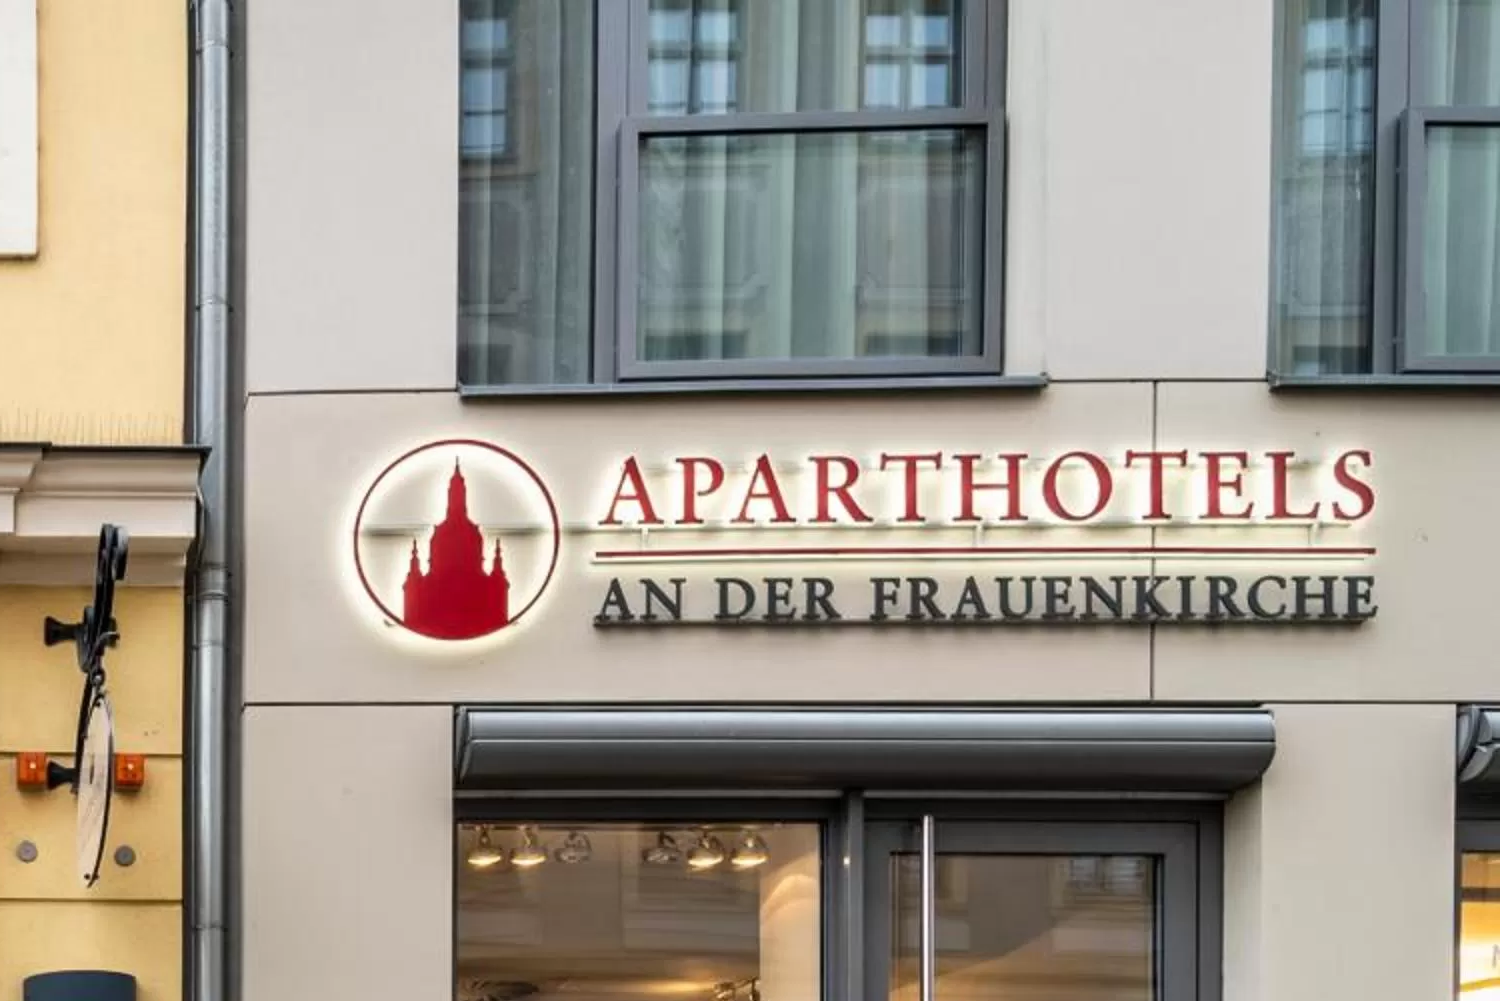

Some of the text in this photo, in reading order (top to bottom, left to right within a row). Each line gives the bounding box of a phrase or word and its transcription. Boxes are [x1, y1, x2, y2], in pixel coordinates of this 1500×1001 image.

[598, 449, 1375, 524] APARTHOTELS
[598, 574, 1378, 621] AN DER FRAUENKIRCHE
